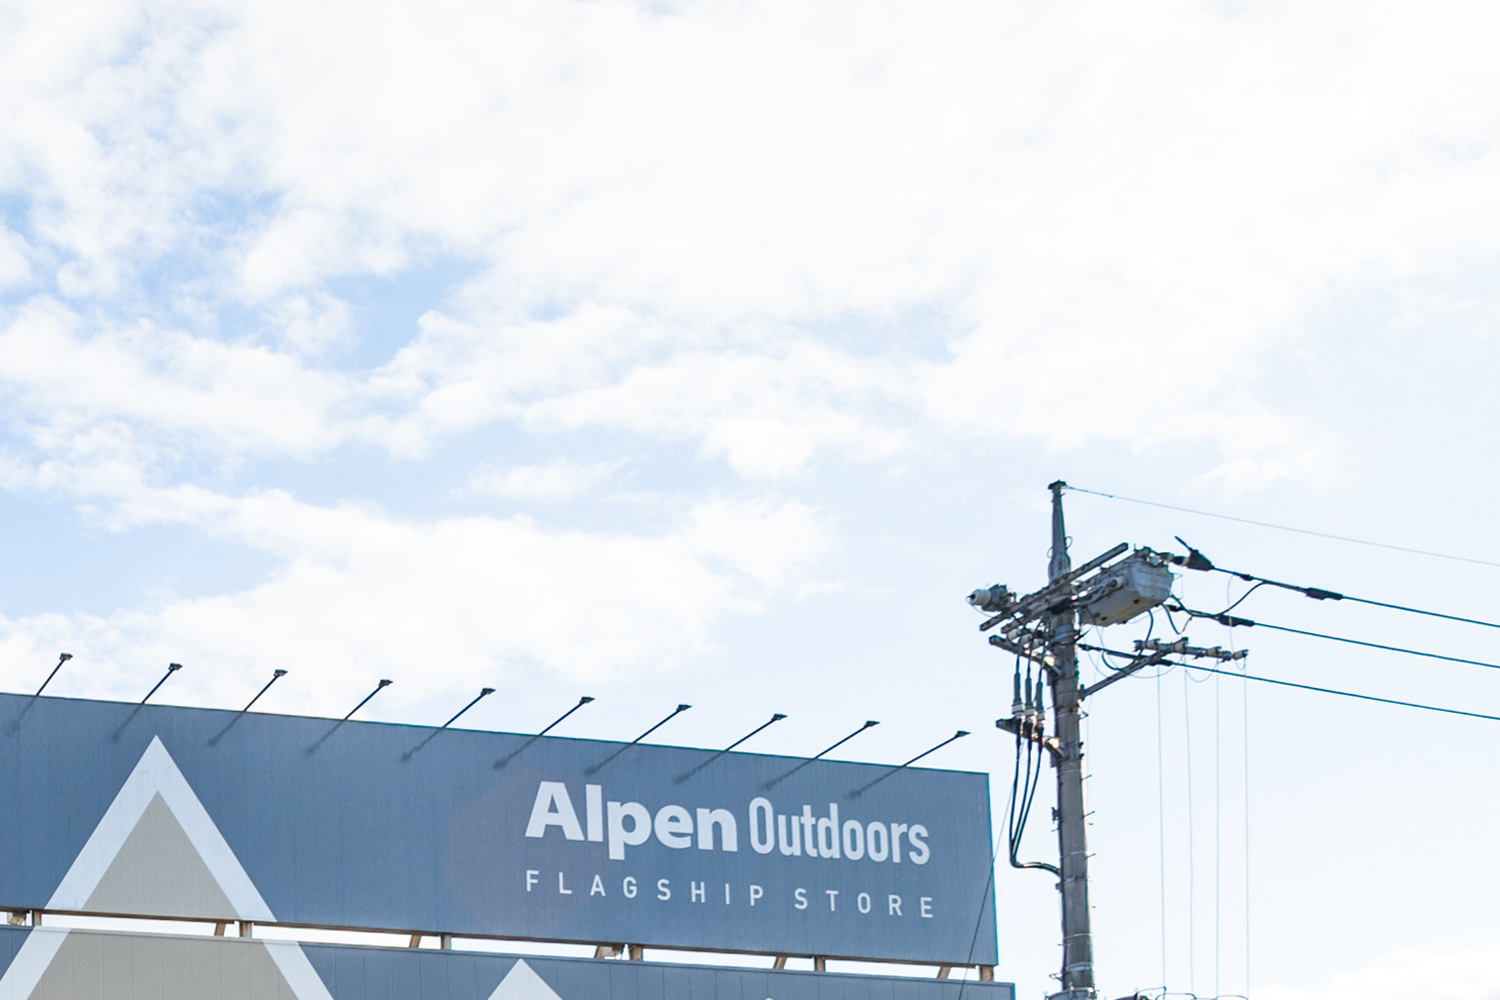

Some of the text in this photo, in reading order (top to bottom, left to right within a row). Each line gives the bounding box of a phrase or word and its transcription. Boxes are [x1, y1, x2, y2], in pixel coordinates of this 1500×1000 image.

[524, 781, 931, 865] Alpen Outdoors
[525, 870, 934, 919] FLAGSHIP STORE
